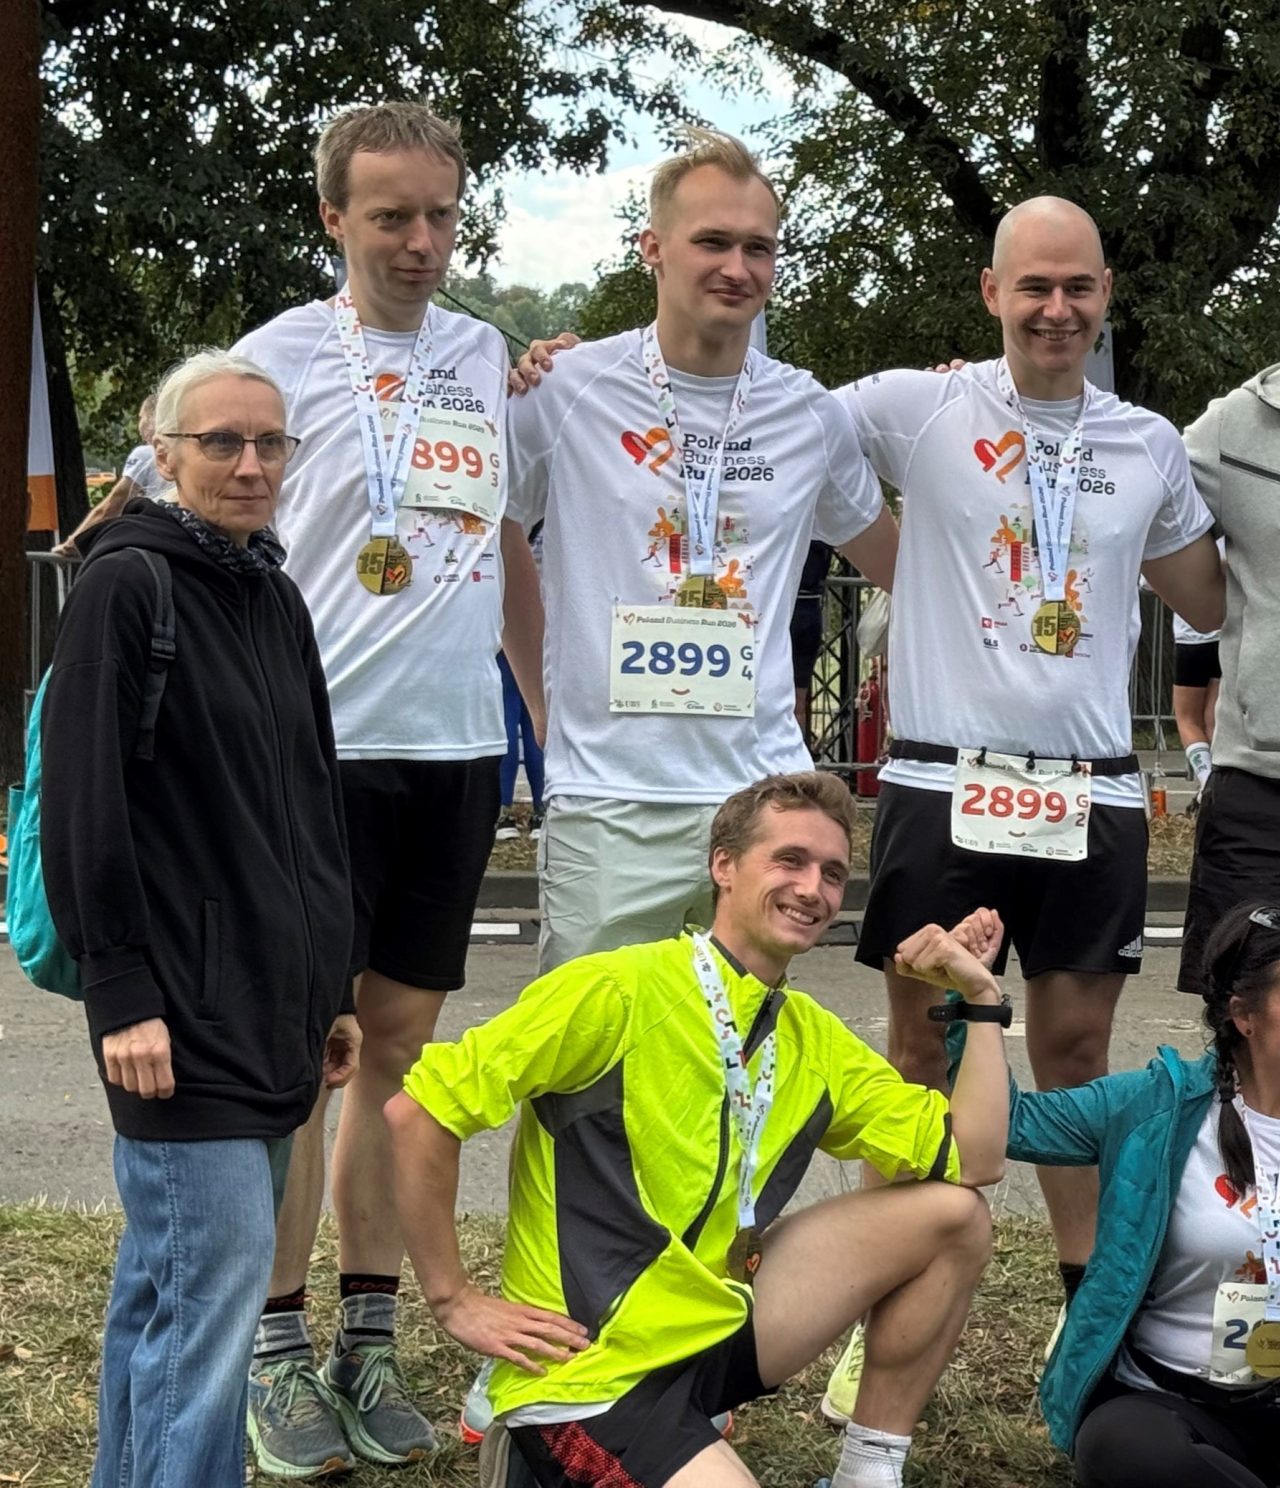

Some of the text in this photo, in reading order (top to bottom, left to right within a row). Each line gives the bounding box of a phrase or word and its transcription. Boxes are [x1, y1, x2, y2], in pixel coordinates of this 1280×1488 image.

[425, 381, 473, 397] siness
[440, 397, 485, 413] 2026
[682, 433, 752, 451] Poland
[1035, 440, 1094, 461] Pold
[384, 434, 483, 479] 899
[489, 452, 500, 469] G
[683, 449, 766, 466] Busness
[679, 465, 774, 481] Ru 2026
[1042, 460, 1106, 479] usess
[490, 473, 499, 488] 3
[1079, 478, 1116, 495] 026
[358, 552, 385, 575] 15
[1033, 616, 1057, 637] 15
[620, 640, 731, 678] 2899
[740, 645, 753, 661] G
[741, 665, 753, 681] 4
[961, 783, 1067, 823] 2899
[1076, 794, 1089, 808] G
[1075, 813, 1086, 827] 2
